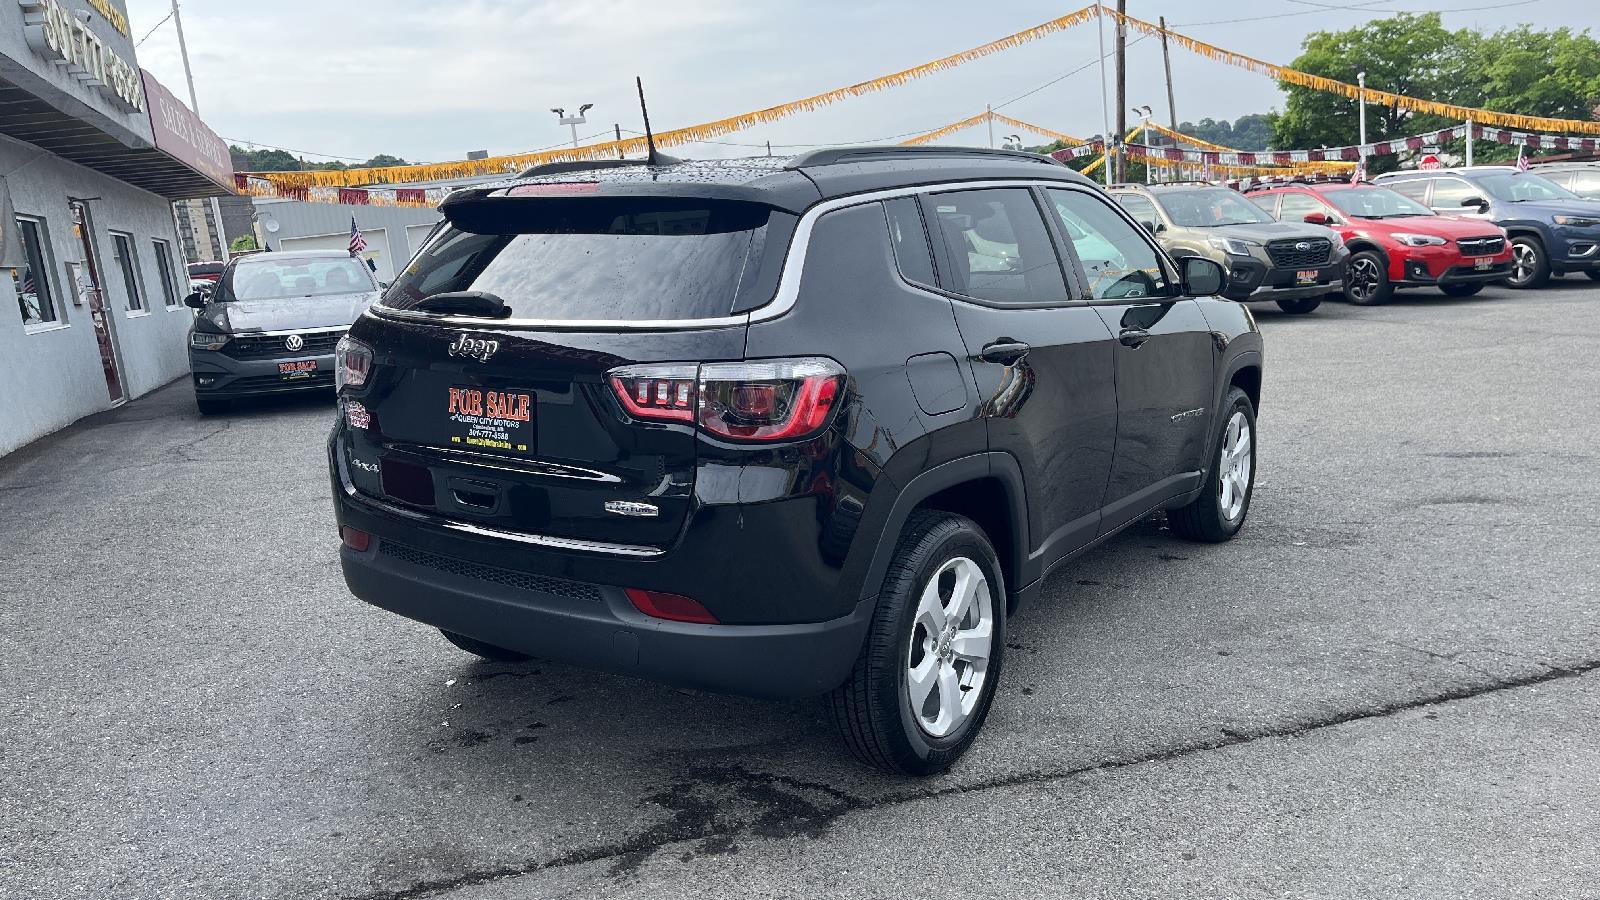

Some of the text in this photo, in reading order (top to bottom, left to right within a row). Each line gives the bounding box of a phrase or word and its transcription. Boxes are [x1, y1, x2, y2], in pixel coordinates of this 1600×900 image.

[159, 97, 189, 143] SALES
[1421, 161, 1440, 171] STOP
[448, 333, 499, 364] Jeep
[448, 387, 530, 422] FOR SALE
[457, 414, 520, 429] QUEEN CITY MOTORS
